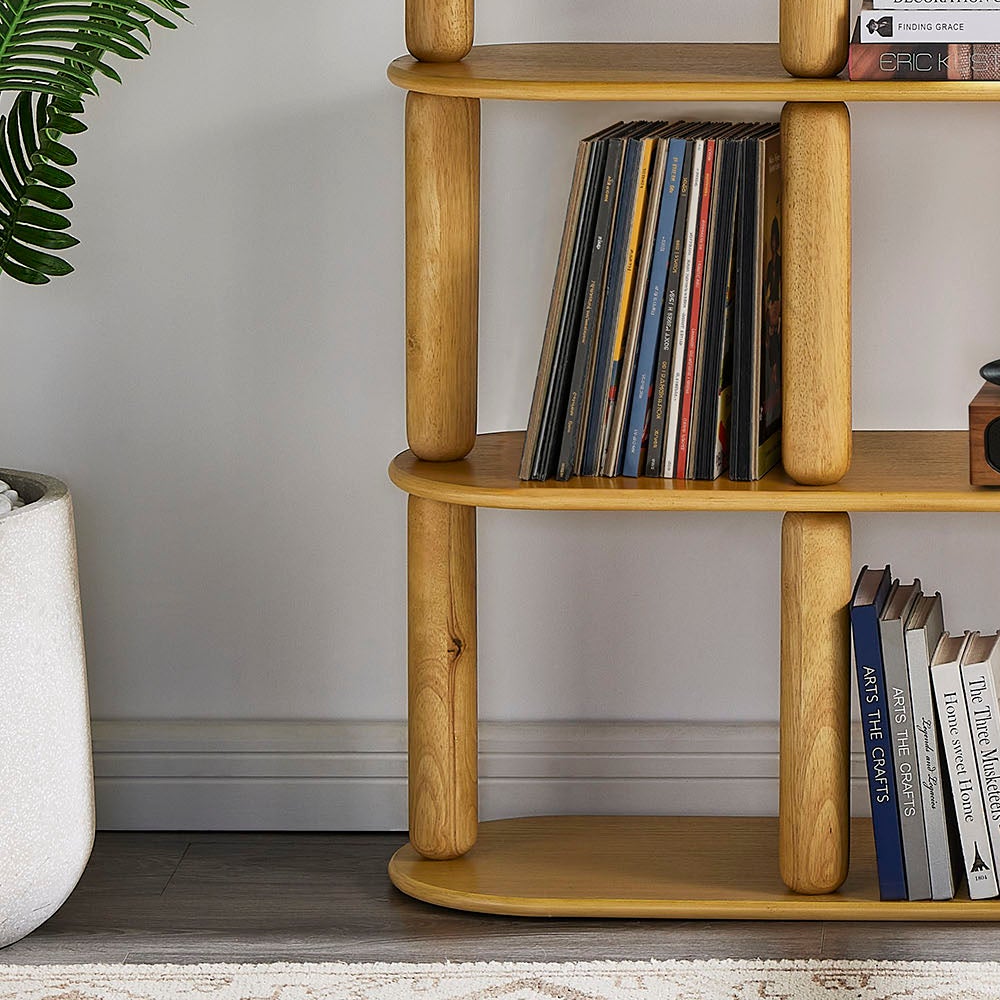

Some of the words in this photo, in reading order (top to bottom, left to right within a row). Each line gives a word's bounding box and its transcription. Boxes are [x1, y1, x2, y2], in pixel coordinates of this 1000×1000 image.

[898, 23, 932, 31] FINDING
[935, 23, 964, 31] GRACE
[879, 52, 933, 72] ERIC
[862, 666, 879, 703] ARTS
[969, 676, 987, 703] The
[892, 687, 907, 724] ARTS
[944, 692, 958, 736] Home
[868, 709, 883, 740] THE
[896, 729, 910, 757] THE
[916, 717, 934, 755] Legends
[974, 706, 992, 745] Three
[872, 747, 889, 803] CRAFTS
[926, 756, 936, 772] and
[952, 739, 967, 776] sweet
[899, 763, 916, 817] CRAFTS
[922, 773, 938, 809] Legacies
[959, 779, 974, 823] Home
